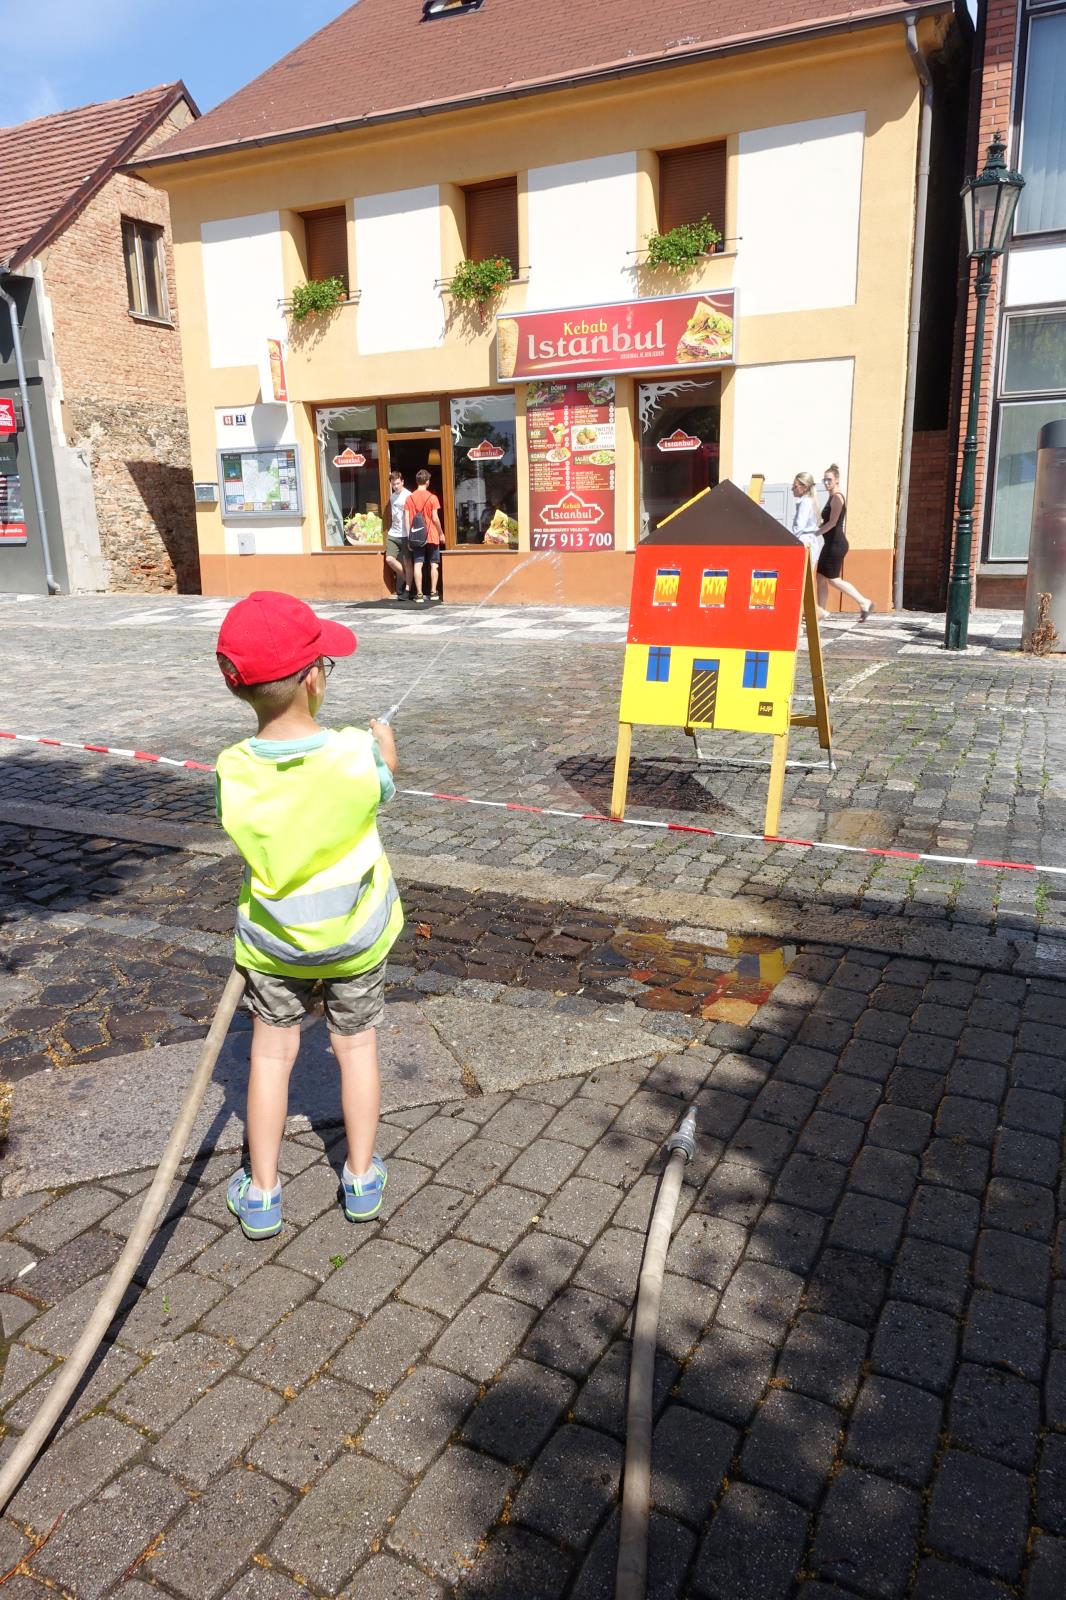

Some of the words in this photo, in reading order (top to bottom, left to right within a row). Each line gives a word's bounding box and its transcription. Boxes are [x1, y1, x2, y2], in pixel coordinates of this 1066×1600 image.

[563, 318, 608, 336] Kebab
[527, 318, 667, 360] Istanbul
[664, 439, 694, 448] Istanbul
[550, 508, 592, 520] Istanbul
[533, 533, 556, 547] 775
[560, 533, 583, 547] 913
[588, 532, 612, 547] 700
